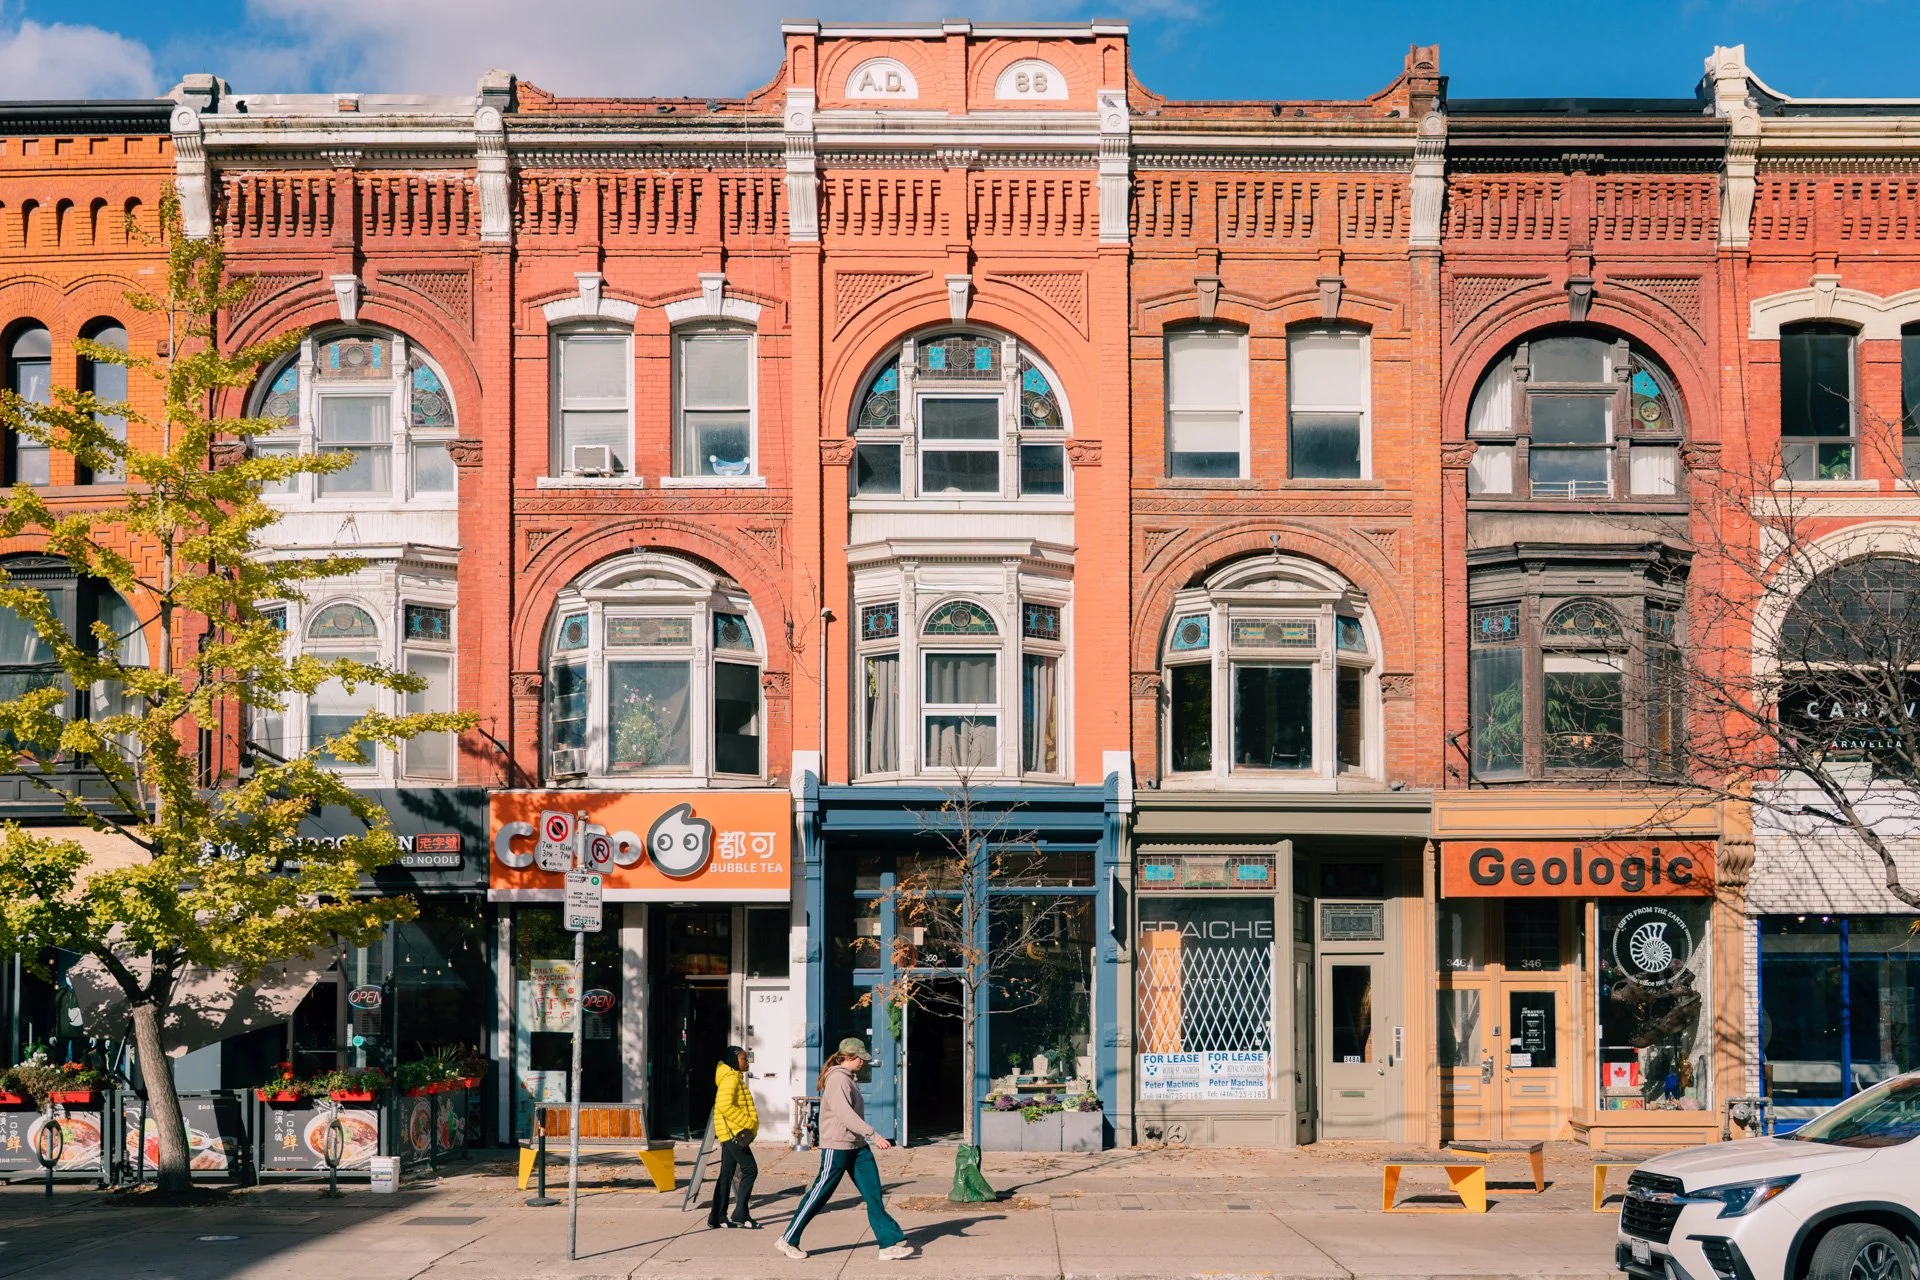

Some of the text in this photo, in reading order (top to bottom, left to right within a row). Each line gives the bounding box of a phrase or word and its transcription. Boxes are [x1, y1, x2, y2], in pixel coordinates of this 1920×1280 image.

[859, 71, 906, 92] A.D.
[1015, 71, 1048, 92] 88
[494, 820, 643, 868] Co
[717, 830, 776, 860] 都可
[417, 855, 460, 864] NOODLE
[710, 862, 783, 873] BUBBLE TEA
[1469, 848, 1693, 892] Geologic
[1617, 912, 1635, 929] GIFTS
[1633, 906, 1653, 917] FROM
[1654, 906, 1668, 915] THE
[1667, 911, 1687, 930] EARTH
[1140, 921, 1273, 939] FRAICHE
[1521, 959, 1542, 968] 346
[351, 991, 382, 1003] OPEN
[582, 995, 612, 1009] OPEN
[1143, 1054, 1200, 1064] FOR LEASE
[1208, 1052, 1264, 1062] FOR LEASE
[1145, 1080, 1200, 1089] Peter MacInnis
[1209, 1078, 1264, 1087] Peter MacInnis
